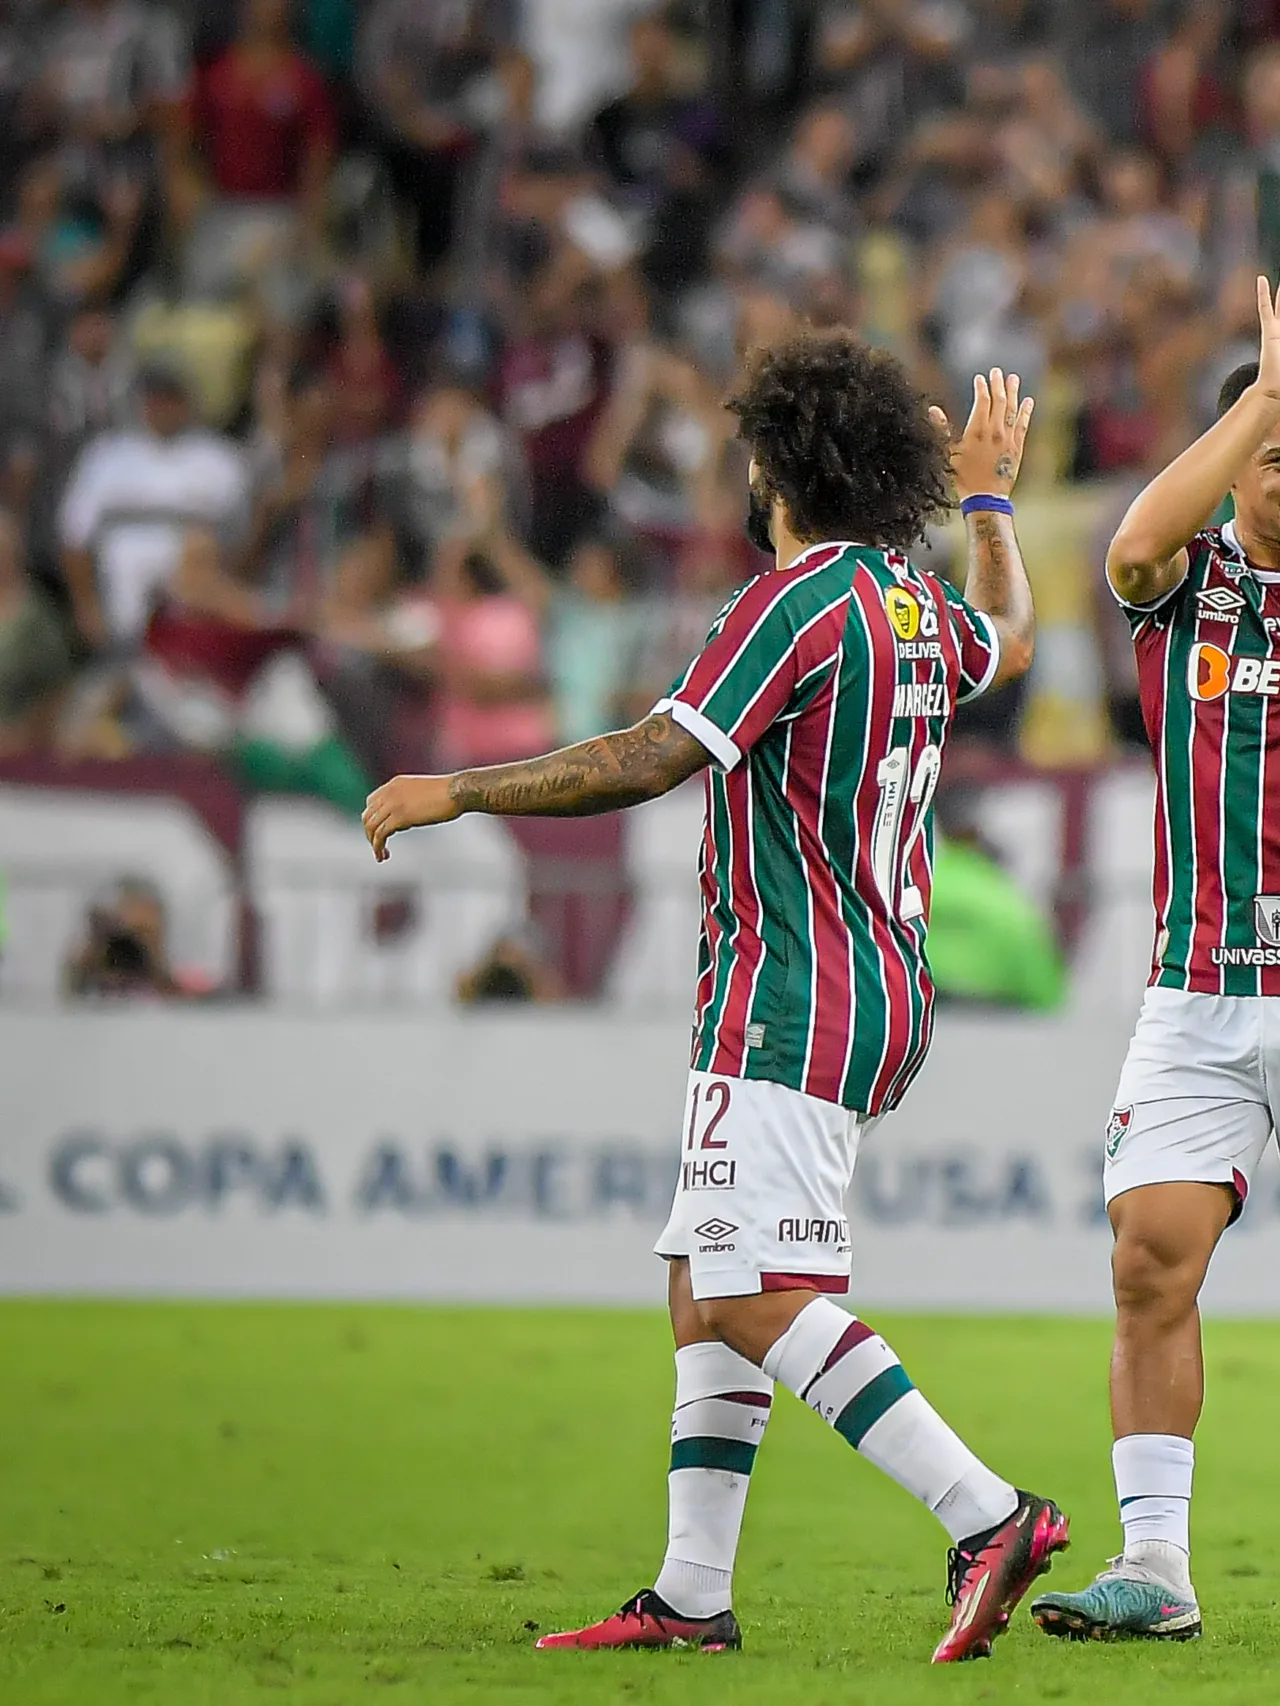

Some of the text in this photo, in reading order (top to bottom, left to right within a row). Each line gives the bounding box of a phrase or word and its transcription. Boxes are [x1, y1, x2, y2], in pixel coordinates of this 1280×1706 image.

[1198, 609, 1239, 624] umbro
[898, 641, 942, 660] DELIVER
[886, 781, 898, 810] TIM
[874, 744, 942, 923] 12
[687, 1081, 731, 1151] 12
[48, 1126, 325, 1216] COPA
[855, 1145, 1055, 1229] USA
[691, 1160, 736, 1187] HCI
[698, 1242, 736, 1253] umbro
